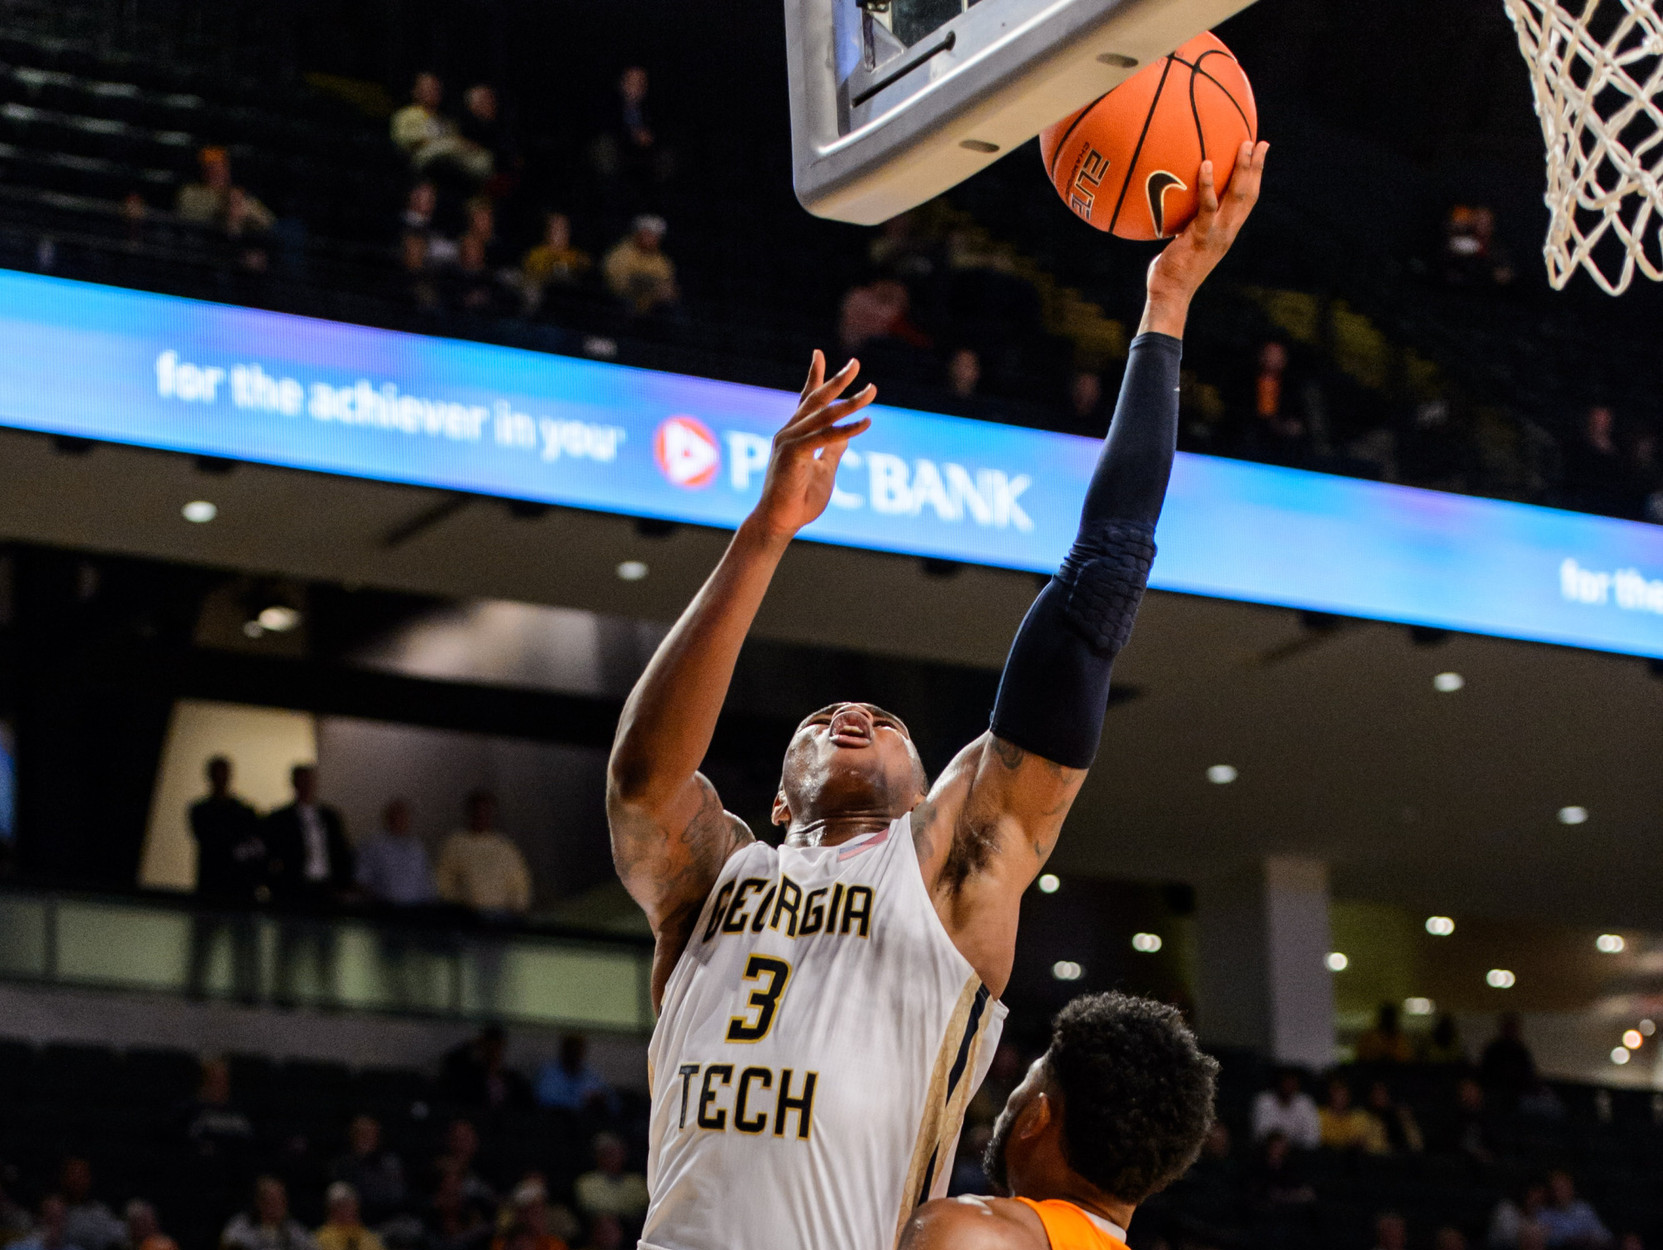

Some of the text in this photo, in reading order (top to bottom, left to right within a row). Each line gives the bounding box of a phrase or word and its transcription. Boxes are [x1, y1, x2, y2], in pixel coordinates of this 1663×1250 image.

[156, 349, 618, 464] for the achiever in you
[725, 430, 1035, 533] PC BANK
[1560, 557, 1609, 606] for
[702, 872, 875, 941] GEORGIA
[725, 953, 793, 1044] 3
[678, 1063, 819, 1141] TECH
